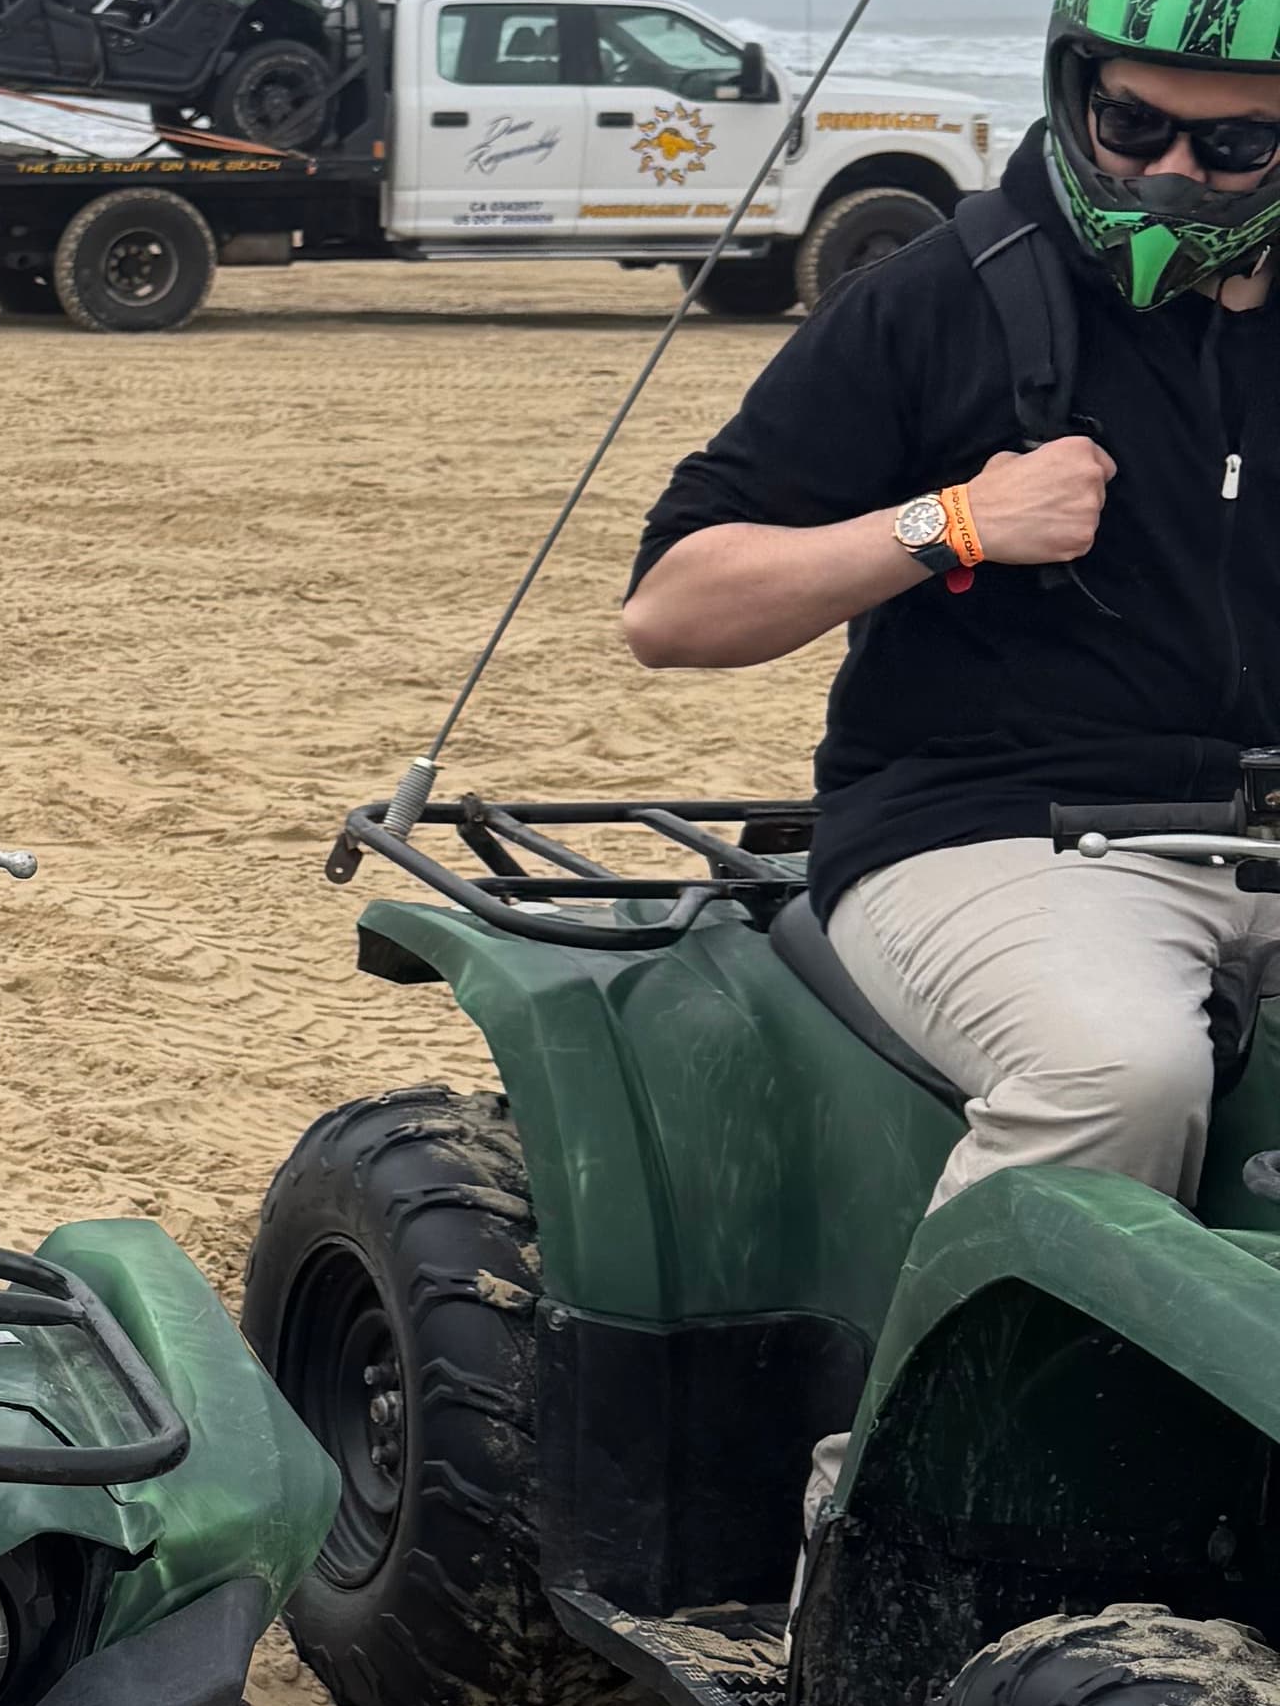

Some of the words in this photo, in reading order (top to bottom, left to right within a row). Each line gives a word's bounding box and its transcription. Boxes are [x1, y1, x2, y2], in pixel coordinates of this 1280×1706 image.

[16, 163, 49, 174] THE
[53, 162, 97, 174] BEST
[100, 162, 156, 173] STUFF
[160, 162, 185, 173] ON
[189, 162, 222, 173] THE
[224, 160, 281, 172] BEACH
